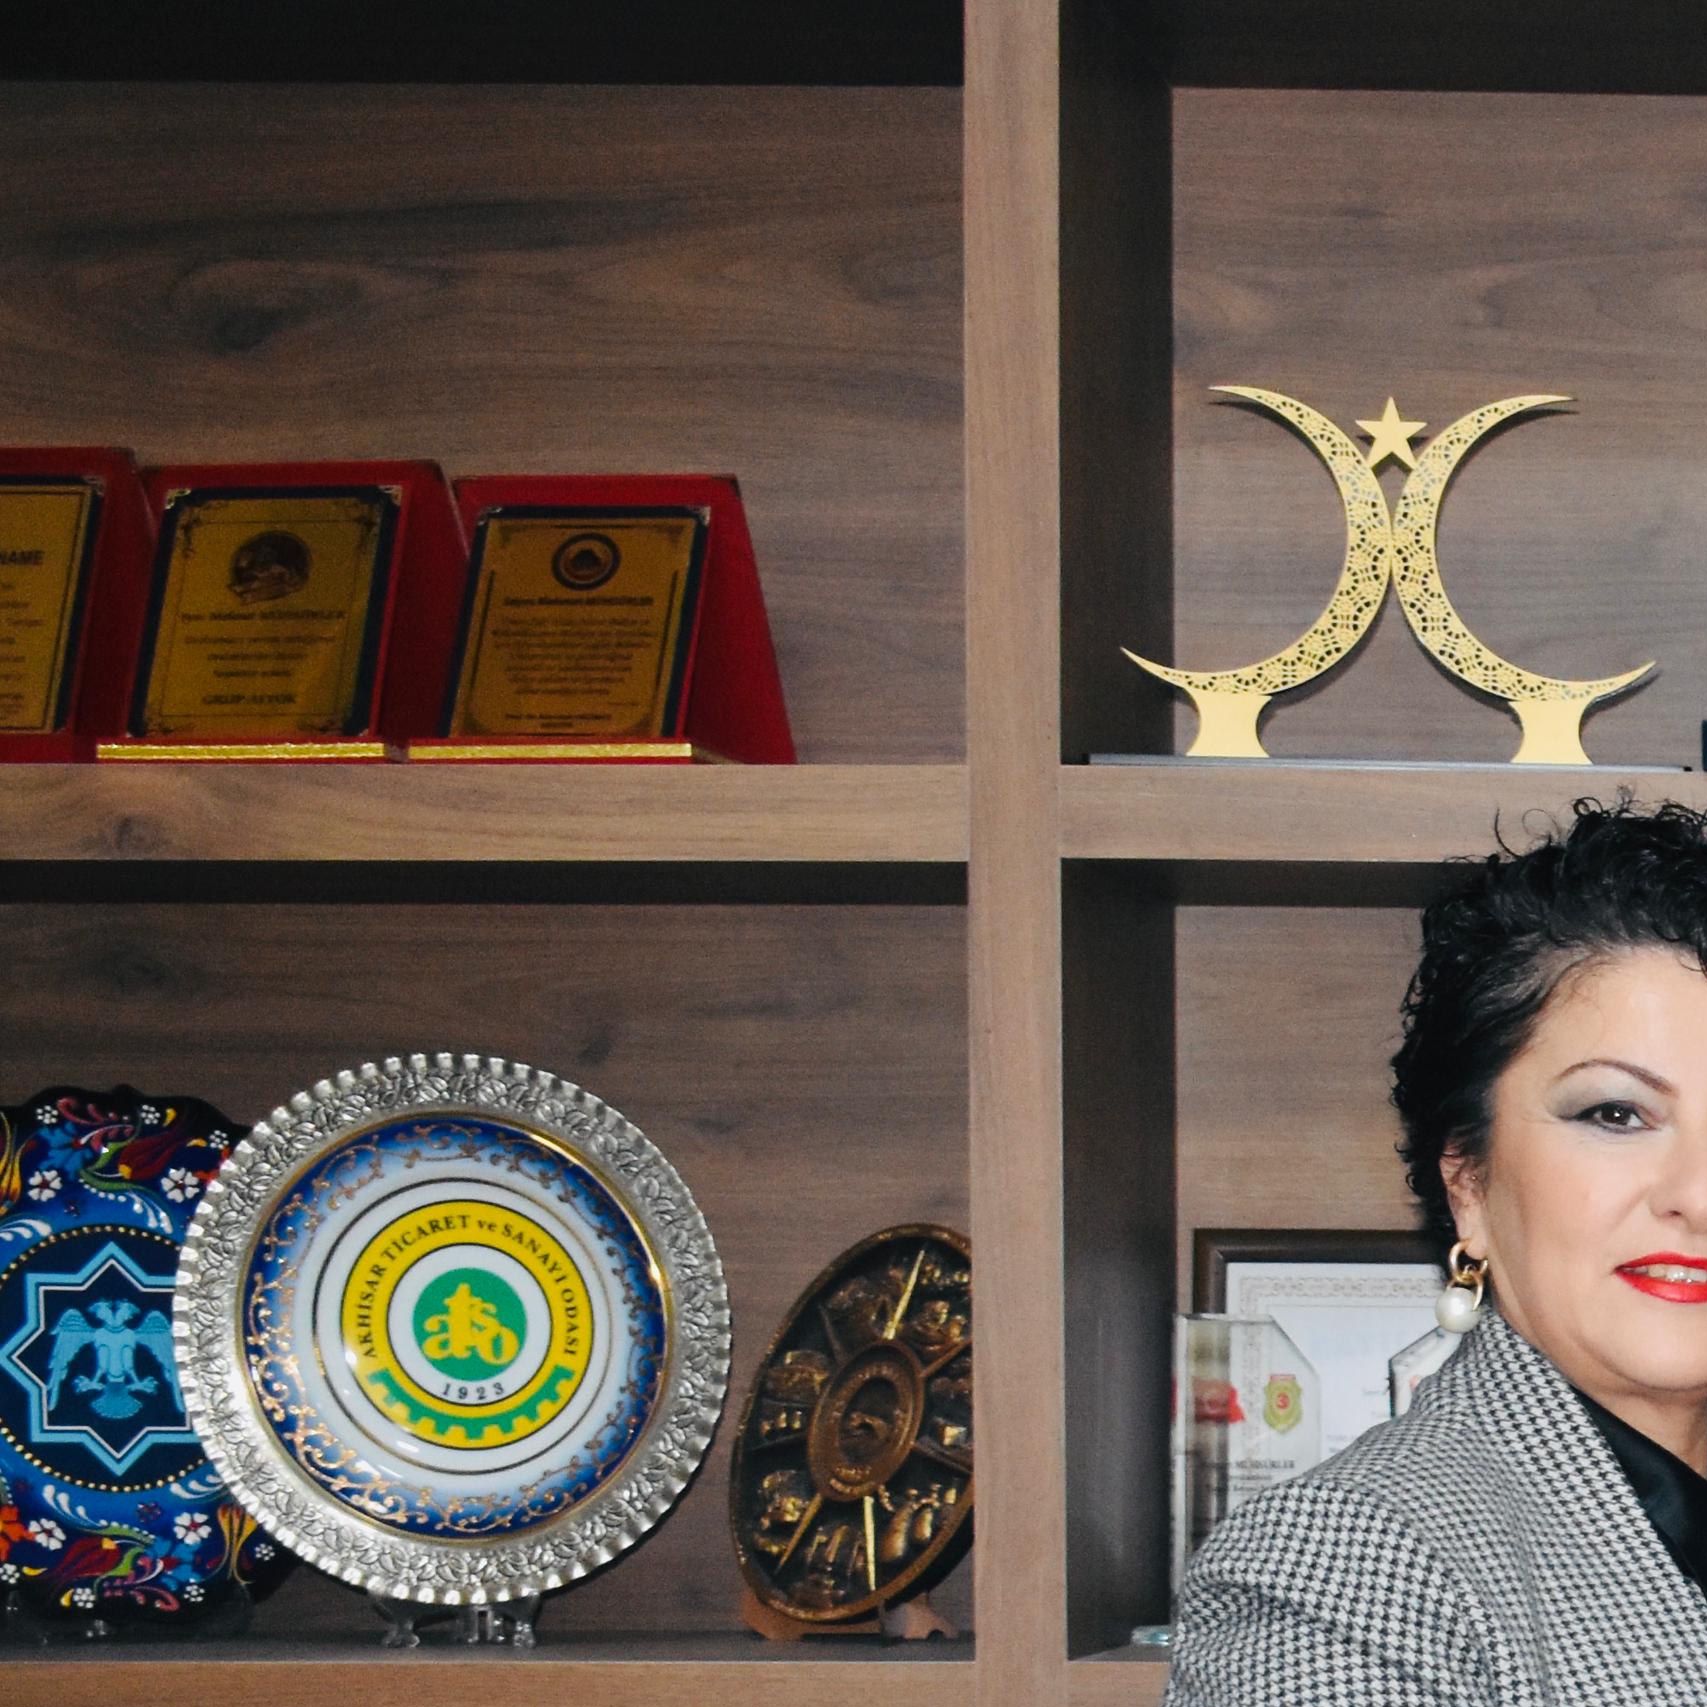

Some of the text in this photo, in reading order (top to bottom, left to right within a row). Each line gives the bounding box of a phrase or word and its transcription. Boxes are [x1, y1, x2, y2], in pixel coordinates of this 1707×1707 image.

[381, 1215, 471, 1262] TİCARET
[477, 1218, 498, 1233] ve
[501, 1223, 568, 1284] SANAYİ
[560, 1287, 580, 1357] ODASI
[441, 1382, 505, 1401] 1923
